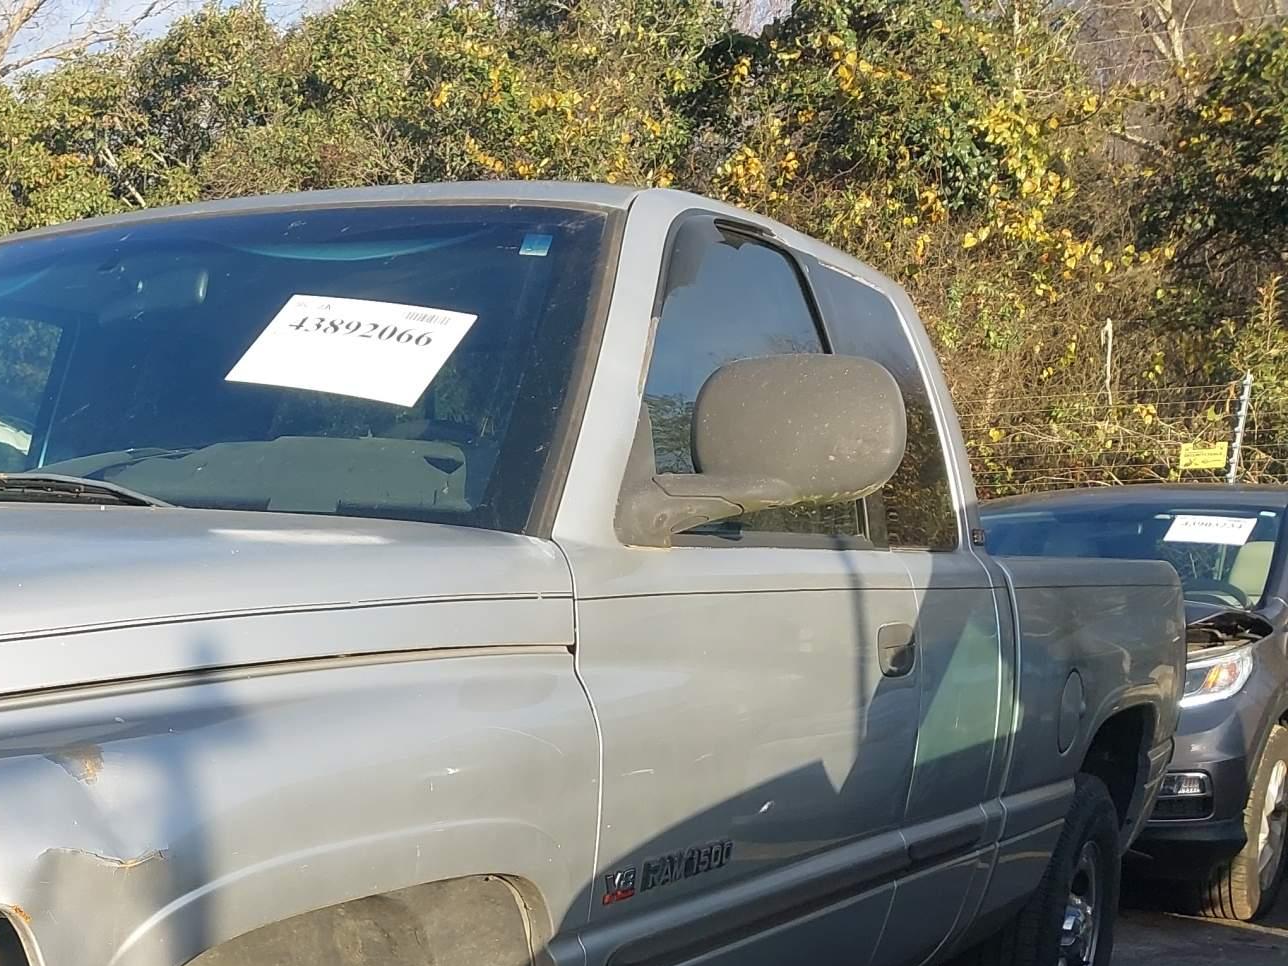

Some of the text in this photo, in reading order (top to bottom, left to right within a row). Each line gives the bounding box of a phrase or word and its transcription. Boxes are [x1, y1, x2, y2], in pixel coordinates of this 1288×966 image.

[288, 316, 433, 347] 43892066
[605, 867, 637, 892] V8
[640, 850, 688, 892] RAM
